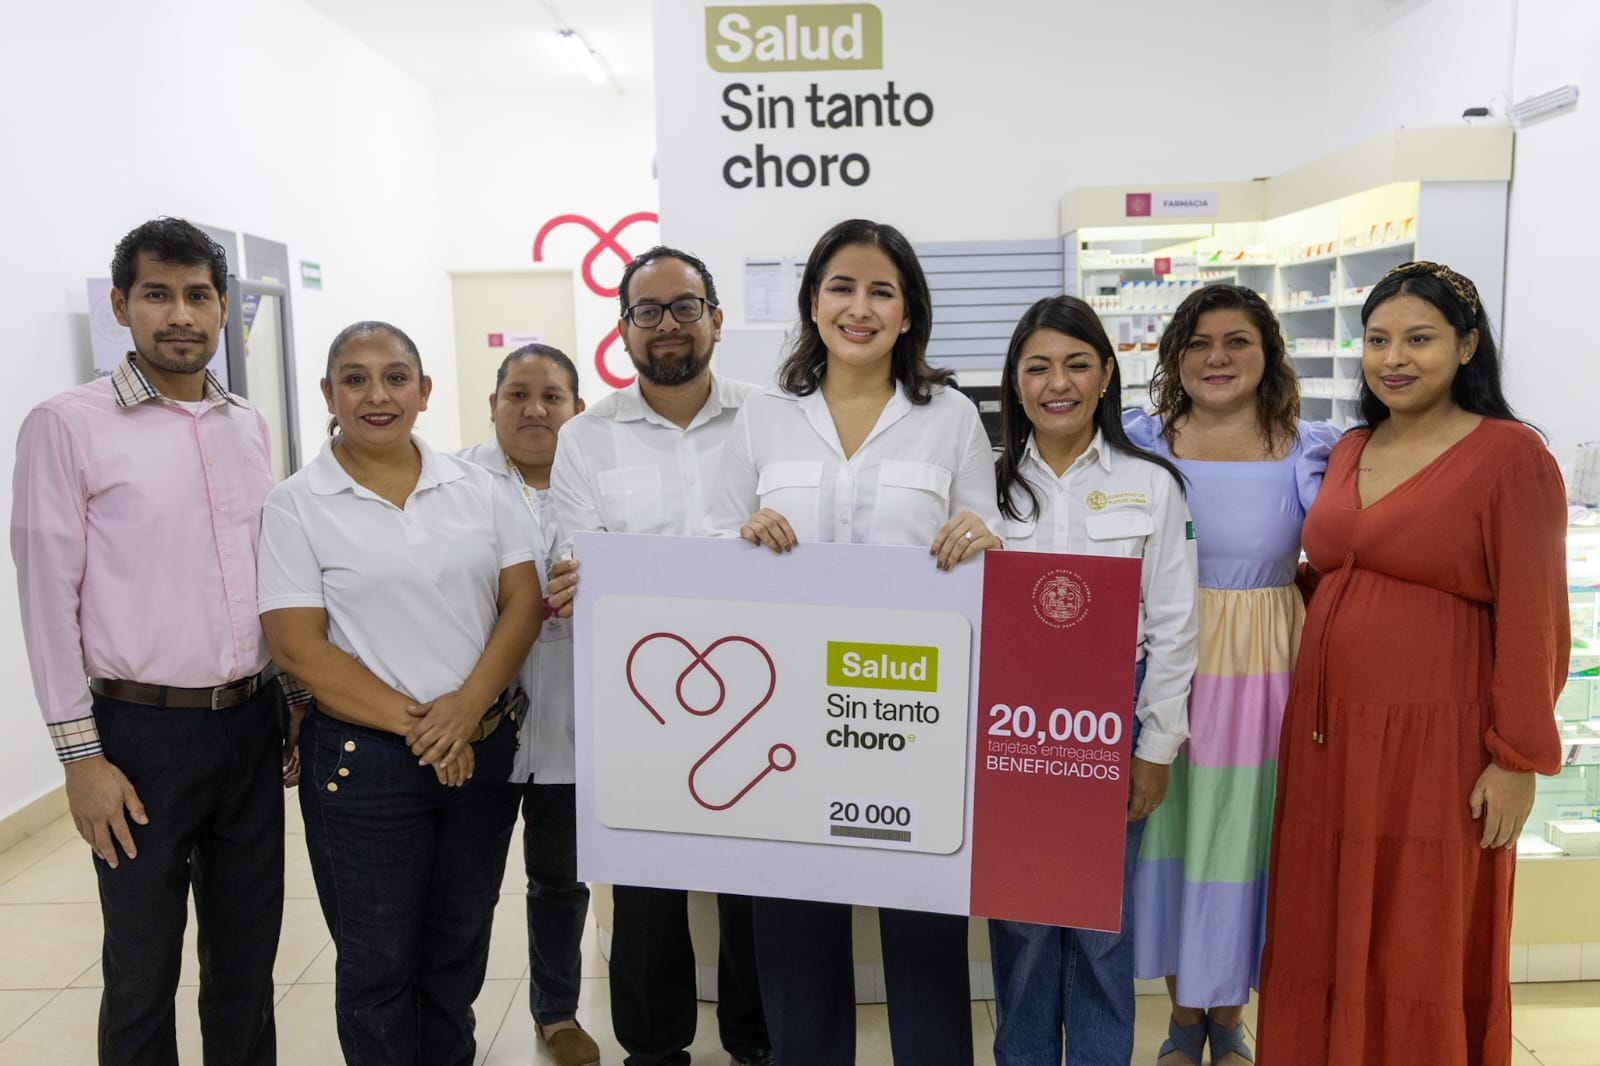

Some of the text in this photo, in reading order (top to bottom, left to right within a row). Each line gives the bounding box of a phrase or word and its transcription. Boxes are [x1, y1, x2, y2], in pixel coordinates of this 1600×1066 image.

[716, 12, 863, 63] Salud
[721, 81, 934, 132] Sin tanto
[722, 144, 871, 189] choro
[1162, 199, 1209, 208] FARMACIA
[841, 651, 927, 681] Salud
[826, 693, 940, 724] Sin tanto
[826, 723, 906, 752] choro
[988, 703, 1123, 746] 20,000
[987, 739, 1120, 763] tarjetas entregadas
[986, 755, 1120, 781] BENEFICIADOS
[829, 801, 911, 826] 20 000
